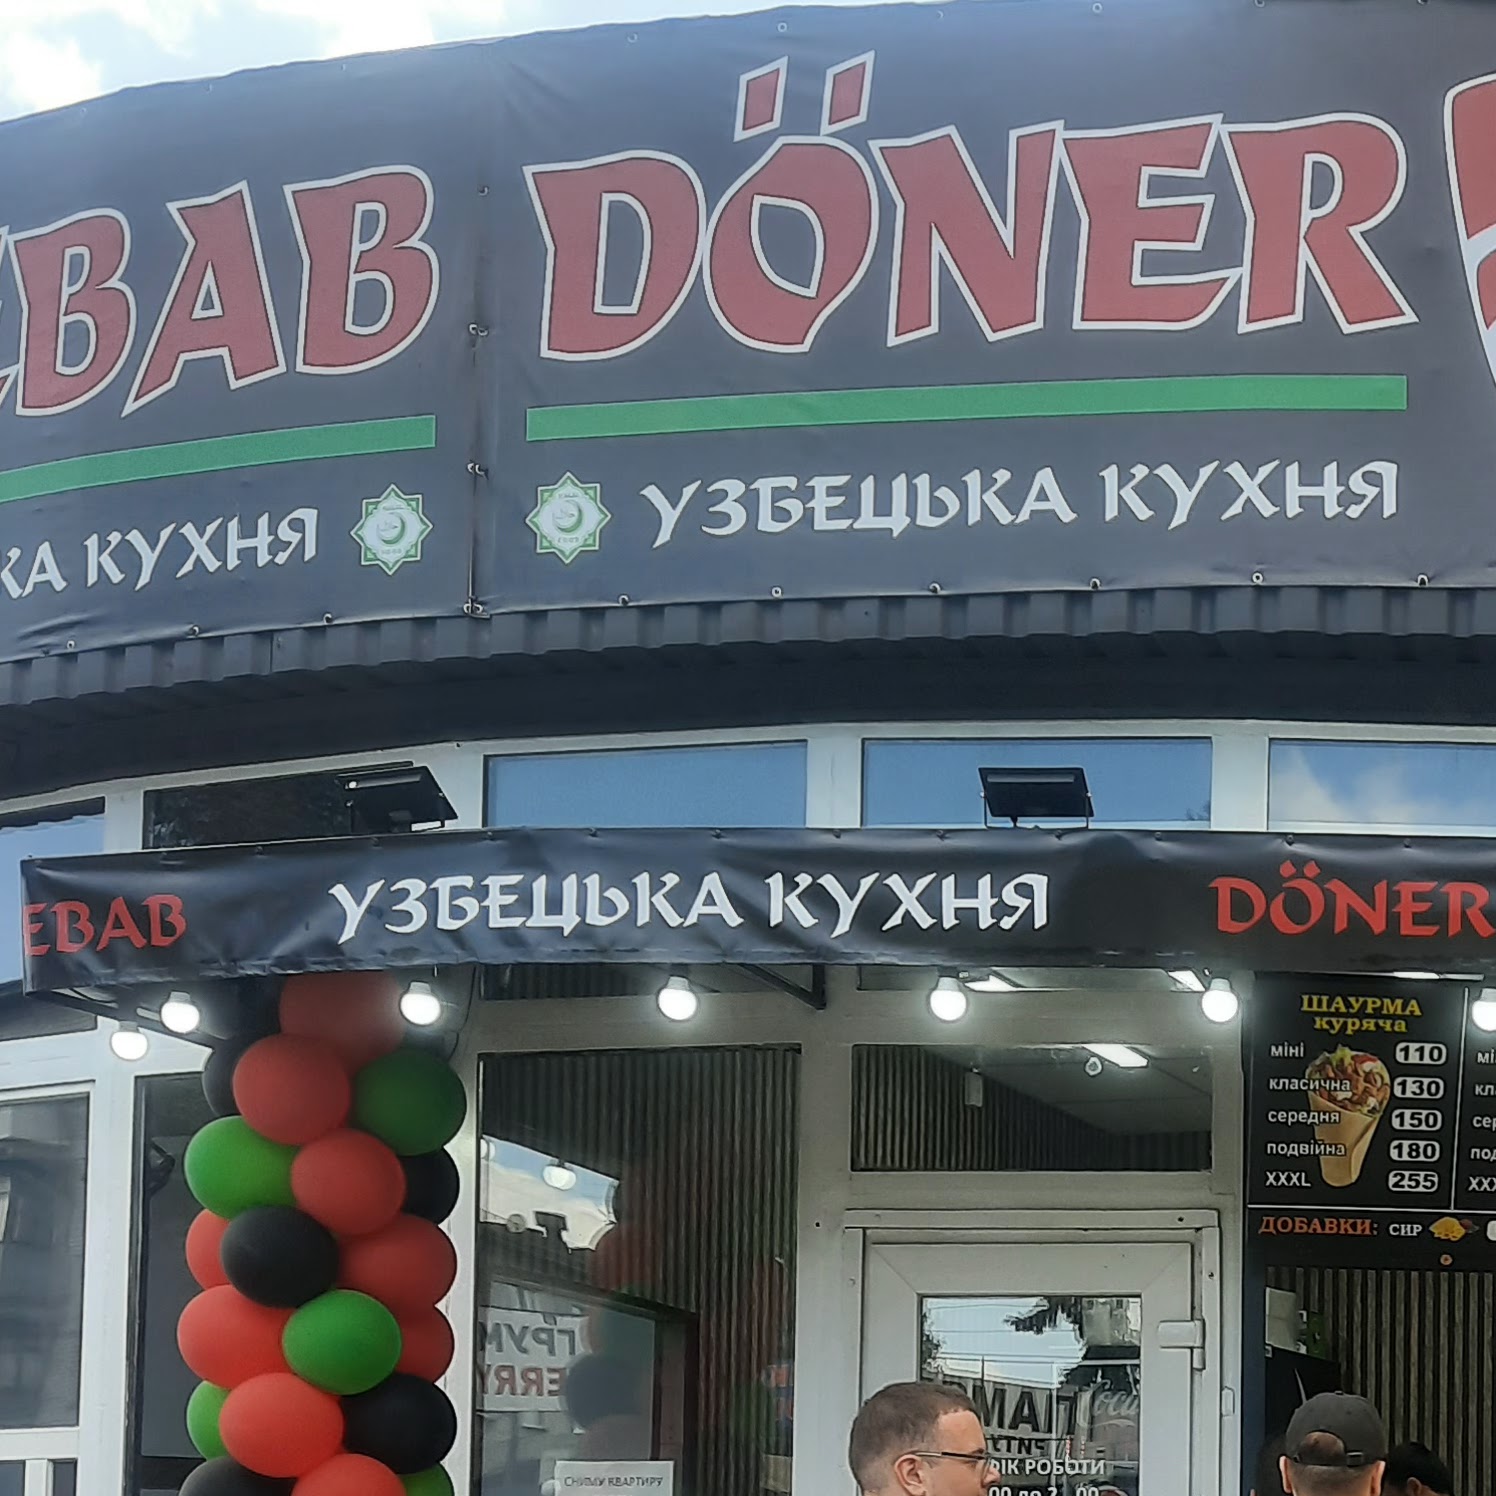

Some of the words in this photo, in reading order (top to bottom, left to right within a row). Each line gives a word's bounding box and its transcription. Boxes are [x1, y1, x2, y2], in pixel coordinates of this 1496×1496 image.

[521, 50, 1420, 362] DÖNER
[0, 165, 439, 416] BAB
[640, 467, 1077, 547] УЗБЕЦЬКА
[1099, 459, 1400, 528] КУХНЯ
[84, 508, 319, 590] КУХНЯ
[329, 873, 744, 943] УЗБЕЦЬКА
[766, 872, 1048, 938] КУХНЯ
[1301, 995, 1422, 1016] ШАУРМА
[1314, 1016, 1408, 1035] куряча
[1270, 1042, 1304, 1057] міні
[1400, 1045, 1443, 1062] 110
[1269, 1077, 1350, 1092] класична
[1398, 1079, 1441, 1096] 130
[1268, 1110, 1340, 1126] середня
[1395, 1111, 1439, 1128] 150
[1267, 1140, 1346, 1157] подвійна
[1393, 1142, 1436, 1160] 180
[1391, 1172, 1437, 1190] 255
[1258, 1216, 1378, 1236] ДОБАВКИ:
[1388, 1224, 1423, 1237] СИР
[1025, 1459, 1105, 1475] РОБОТИ
[564, 1476, 605, 1487] СНИМУ
[607, 1476, 663, 1487] КВАРТИРУ
